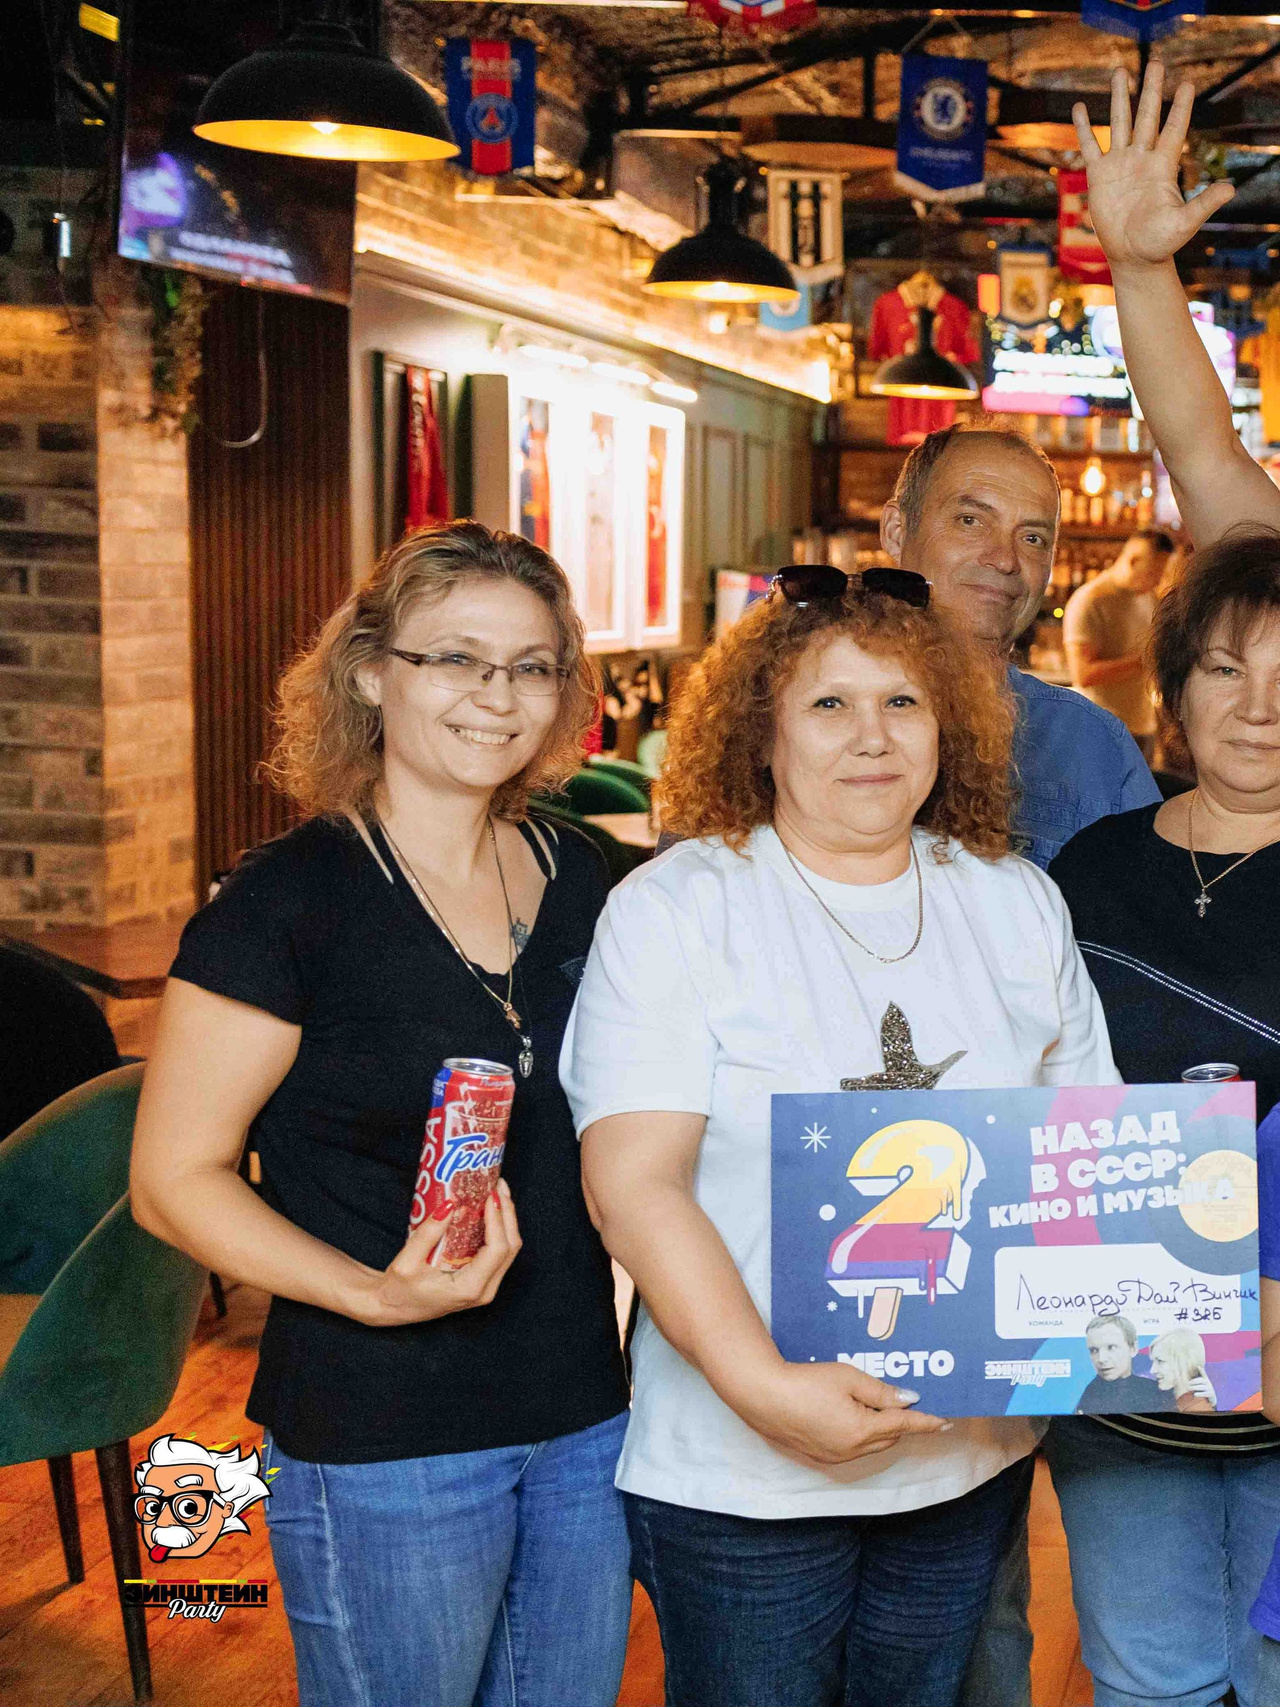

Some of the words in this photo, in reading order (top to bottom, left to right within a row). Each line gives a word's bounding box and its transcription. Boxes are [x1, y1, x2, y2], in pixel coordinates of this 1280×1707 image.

[1029, 1110, 1181, 1156] НАЗАД
[1030, 1163, 1060, 1194] В
[1066, 1149, 1187, 1189] СССР:
[988, 1197, 1072, 1229] КИНО
[1076, 1194, 1099, 1218] И
[1103, 1176, 1236, 1214] МУЗЫКА
